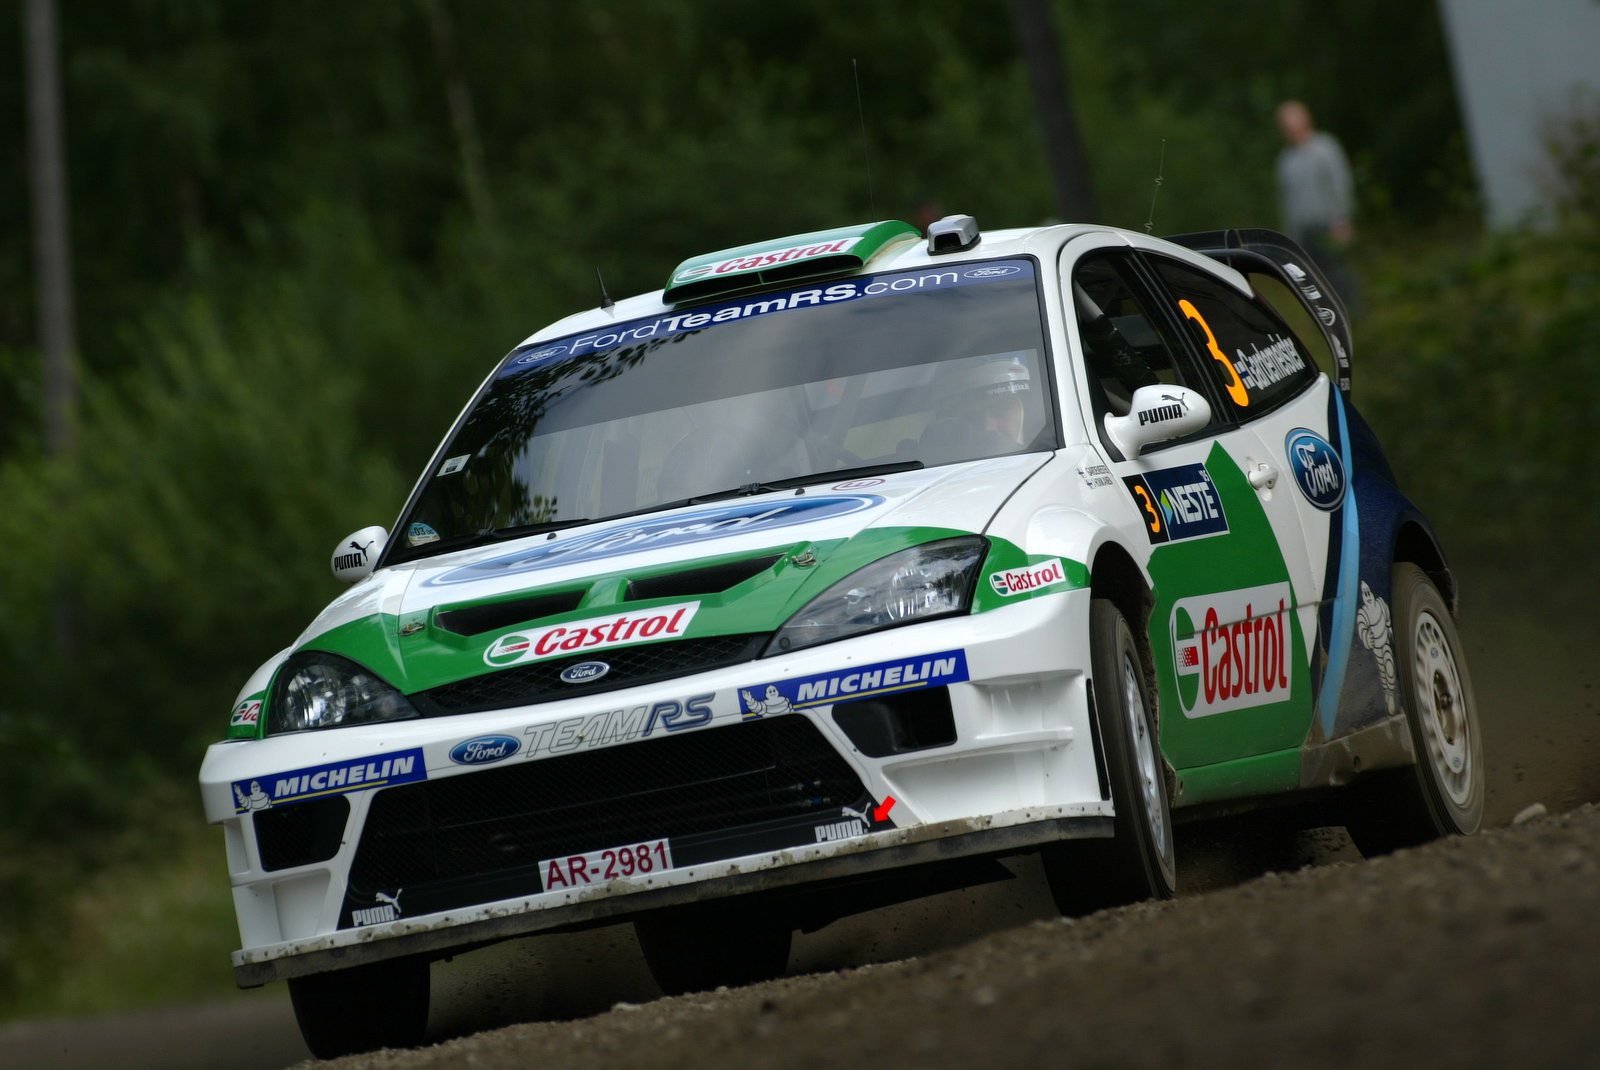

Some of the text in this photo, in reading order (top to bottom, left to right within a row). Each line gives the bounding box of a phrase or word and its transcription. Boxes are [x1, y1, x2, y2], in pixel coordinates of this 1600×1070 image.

[714, 238, 850, 275] Castrol
[569, 271, 958, 355] FordTeamRS.com
[1178, 299, 1249, 407] 3
[1138, 403, 1183, 426] PUMA
[1295, 441, 1340, 498] Ford
[1134, 481, 1220, 533] 3 NESTE
[505, 505, 793, 569] Ford
[334, 552, 362, 572] PUMA
[1004, 563, 1064, 593] Castrol
[534, 607, 688, 656] Castrol
[1202, 597, 1288, 705] Castrol
[569, 664, 598, 680] Ford
[797, 656, 957, 702] MICHELIN
[462, 737, 508, 762] Ford
[274, 755, 415, 798] MICHELIN
[815, 820, 863, 843] PUMA
[546, 840, 669, 890] AR-2981
[352, 905, 396, 927] PUMA
